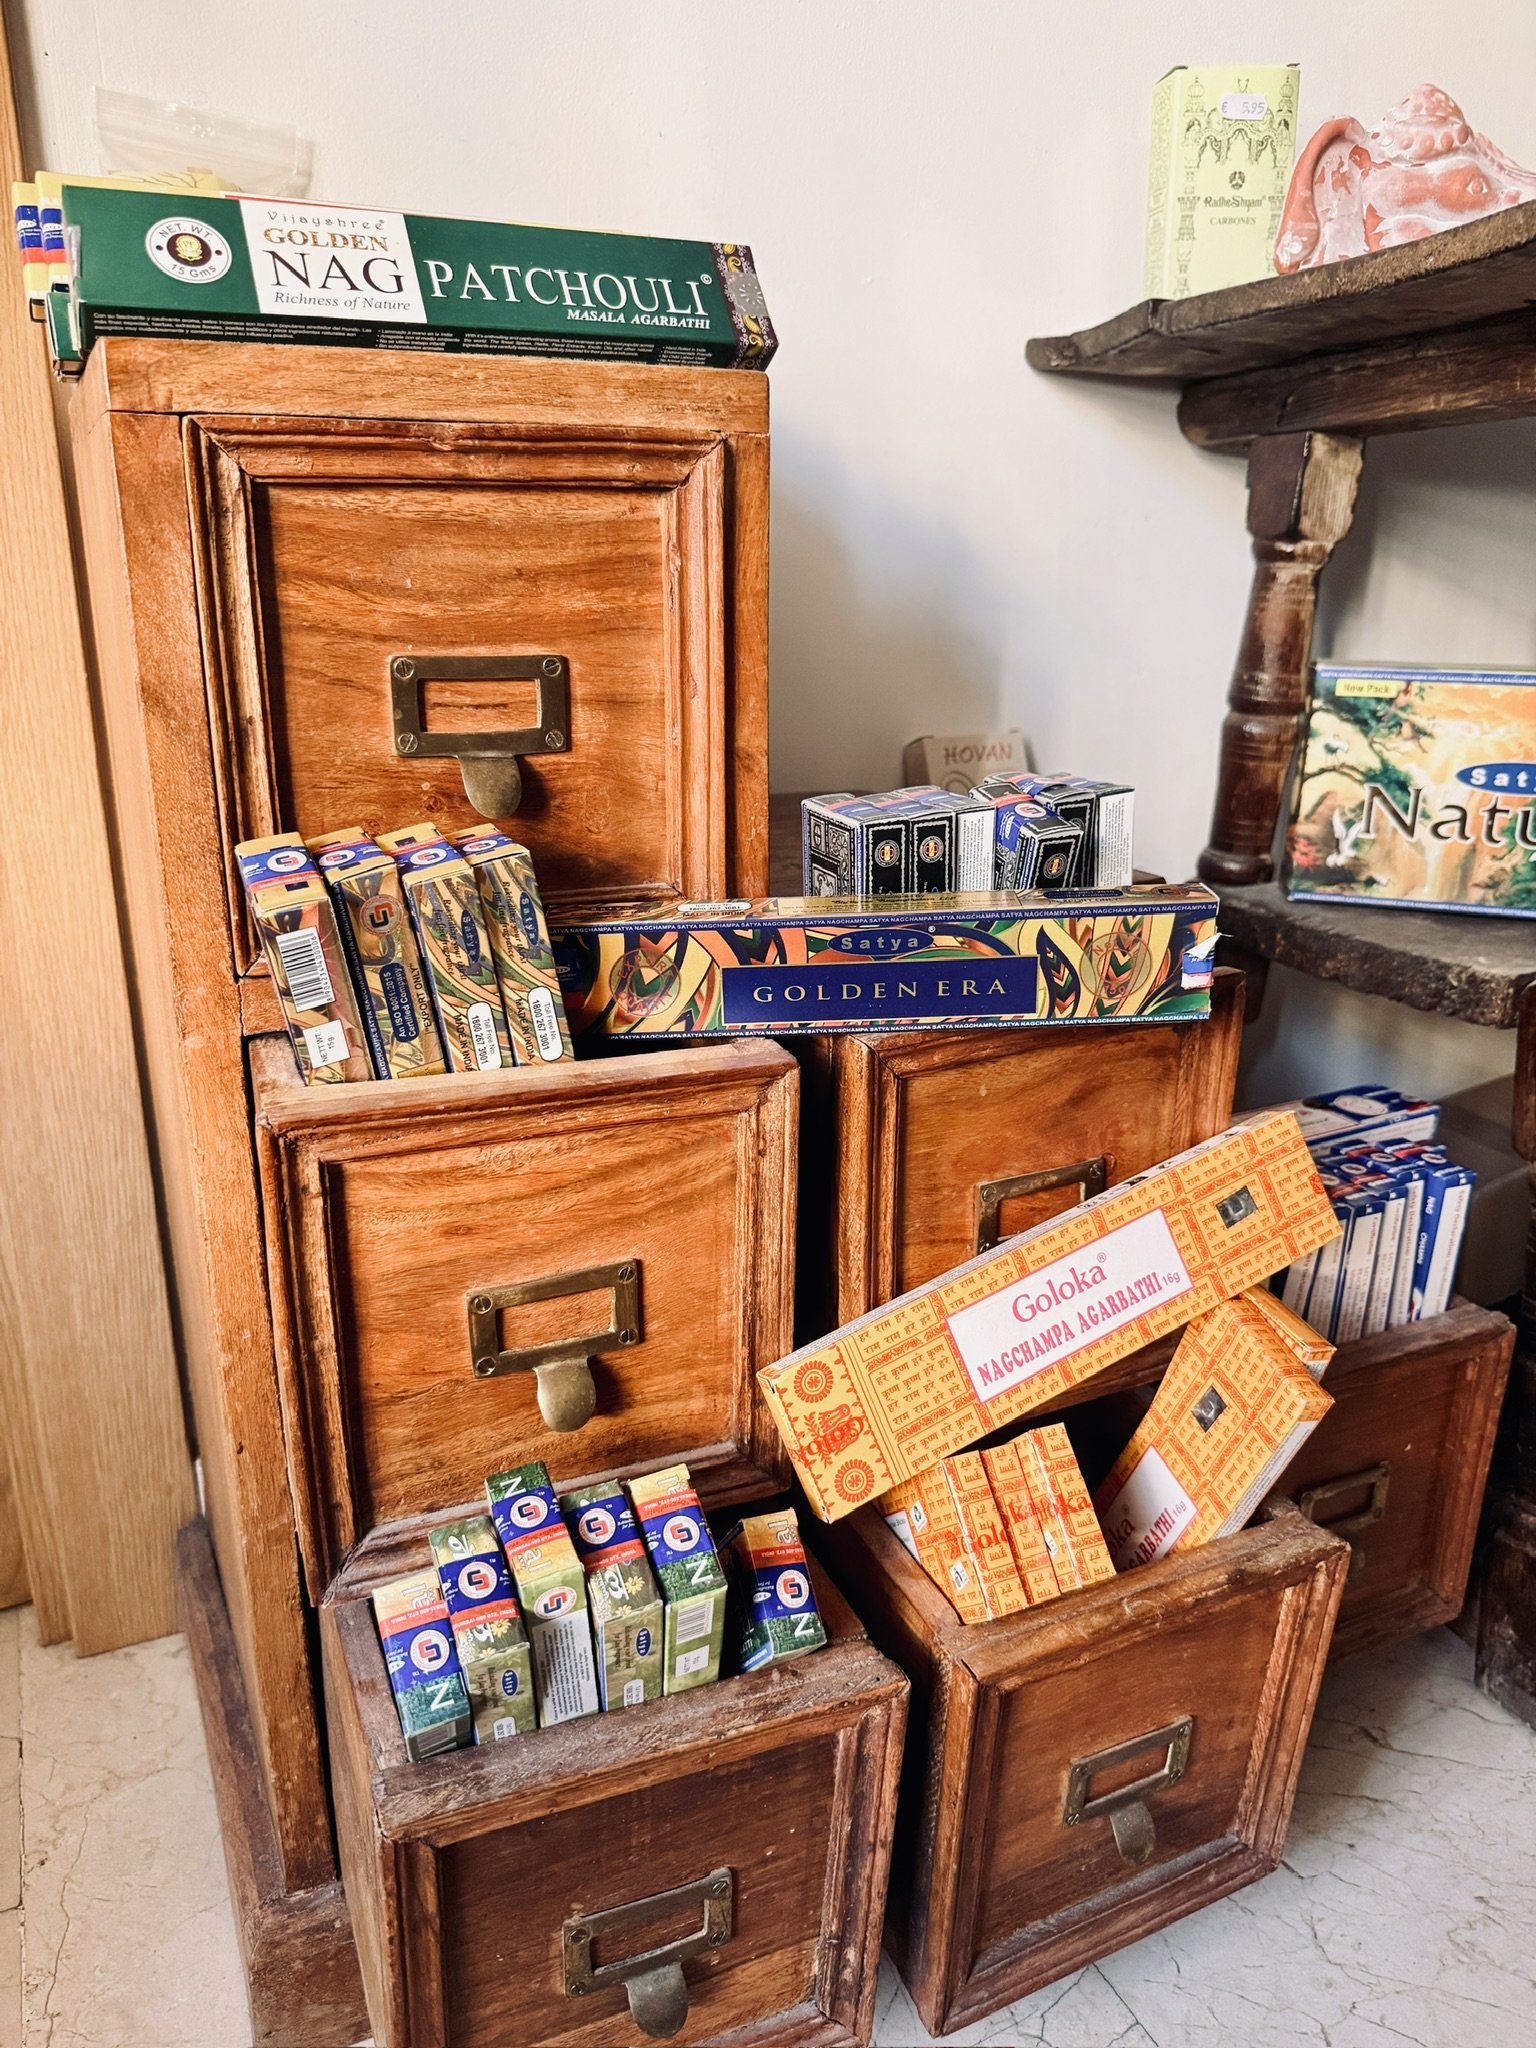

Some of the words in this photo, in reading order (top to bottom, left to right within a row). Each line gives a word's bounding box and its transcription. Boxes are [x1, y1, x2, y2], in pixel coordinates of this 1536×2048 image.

[1242, 101, 1265, 113] 5.95
[267, 211, 385, 231] Vijayshree
[1210, 217, 1256, 225] CARBONES
[263, 227, 389, 252] GOLDEN
[189, 264, 218, 279] Gms
[263, 250, 405, 294] NAG
[424, 260, 709, 315] PATCHOULI
[274, 291, 339, 307] Richness
[344, 294, 360, 309] of
[362, 296, 411, 311] Nature
[567, 309, 625, 324] MASALA
[630, 313, 710, 329] AGARBATHI
[1344, 683, 1364, 693] New
[1366, 684, 1389, 694] Pack
[944, 742, 1012, 764] HOVAN
[1470, 768, 1536, 793] Sat
[520, 897, 536, 939] Satya
[634, 923, 675, 931] NAGCHAMPA
[698, 921, 740, 929] NAGCHAMPA
[762, 919, 803, 927] NAGCHAMPA
[955, 912, 1000, 920] NAGCHAMPA
[1024, 909, 1068, 917] NAGCHAMPA
[1069, 908, 1091, 916] SATYA
[1092, 906, 1137, 914] NAGCHAMPA
[1161, 904, 1206, 912] NAGCHAMPA
[840, 935, 919, 951] Satya
[383, 971, 399, 1010] 9001:2015
[393, 967, 409, 1003] Company
[752, 981, 918, 1002] GOLDEN
[937, 978, 1006, 996] ERA
[394, 1011, 402, 1025] ISO
[515, 999, 526, 1024] MADE
[531, 999, 542, 1018] 1800
[402, 1004, 415, 1036] Certified
[453, 1015, 465, 1037] MADE
[471, 1015, 481, 1032] 1800
[521, 1026, 529, 1034] IN
[536, 1019, 545, 1031] 267
[640, 1032, 681, 1040] NAGCHAMPA
[703, 1030, 744, 1038] NAGCHAMPA
[765, 1028, 806, 1036] NAGCHAMPA
[827, 1026, 868, 1034] NAGCHAMPA
[954, 1021, 997, 1029] NAGCHAMPA
[1086, 1016, 1128, 1024] NAGCHAMPA
[398, 1026, 405, 1036] An
[475, 1033, 484, 1045] 267
[485, 1029, 493, 1043] Free
[326, 1036, 336, 1048] 15g
[459, 1040, 467, 1048] IN
[523, 1036, 535, 1060] INDIA
[539, 1033, 549, 1050] 3001
[317, 1043, 328, 1061] NETT
[461, 1050, 472, 1071] INDIA
[477, 1046, 488, 1063] 3001
[1424, 1195, 1436, 1216] NAG
[1012, 1263, 1107, 1323] Goloka
[976, 1319, 1076, 1387] NAGCHAMPA
[1078, 1271, 1163, 1334] AGARBATHI
[1161, 1271, 1181, 1287] 16g
[1125, 1507, 1176, 1570] GARBATHI
